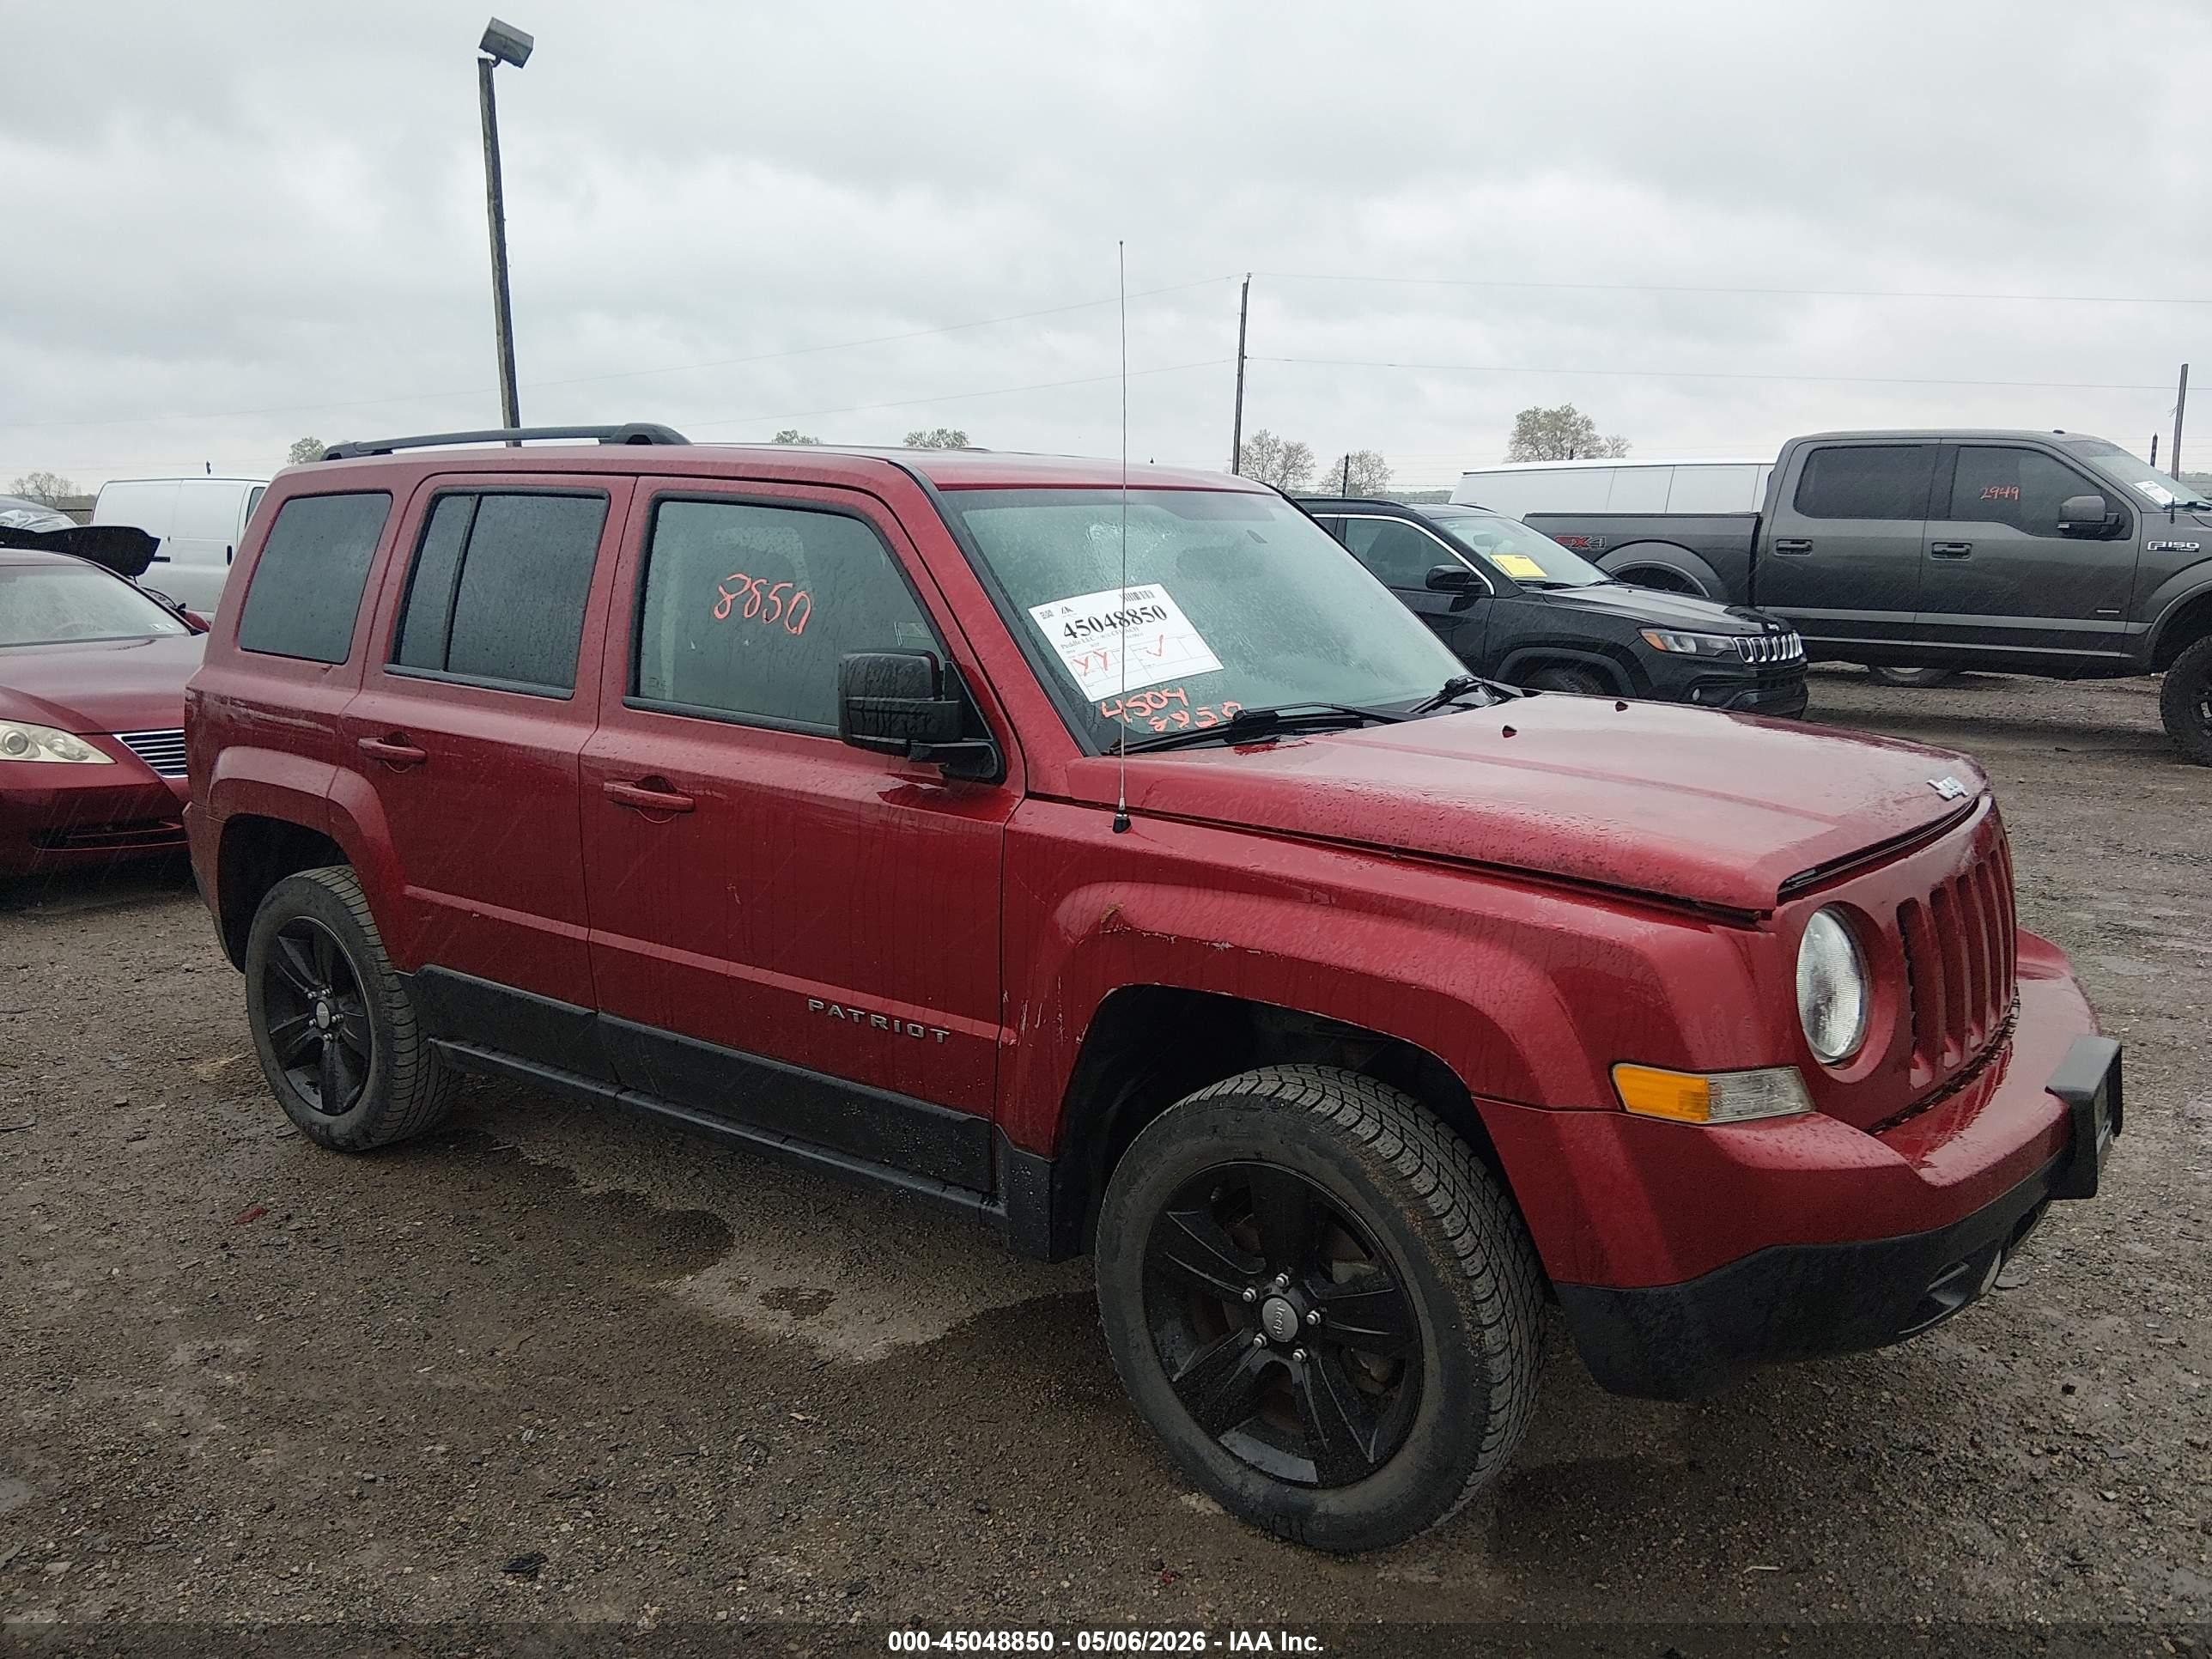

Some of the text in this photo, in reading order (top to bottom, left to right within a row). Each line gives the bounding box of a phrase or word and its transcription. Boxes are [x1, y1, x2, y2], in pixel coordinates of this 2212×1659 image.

[1979, 486, 2020, 501] 2949
[714, 573, 811, 635] 8850
[1063, 605, 1167, 639] 45048850
[808, 999, 951, 1043] PATRIOT
